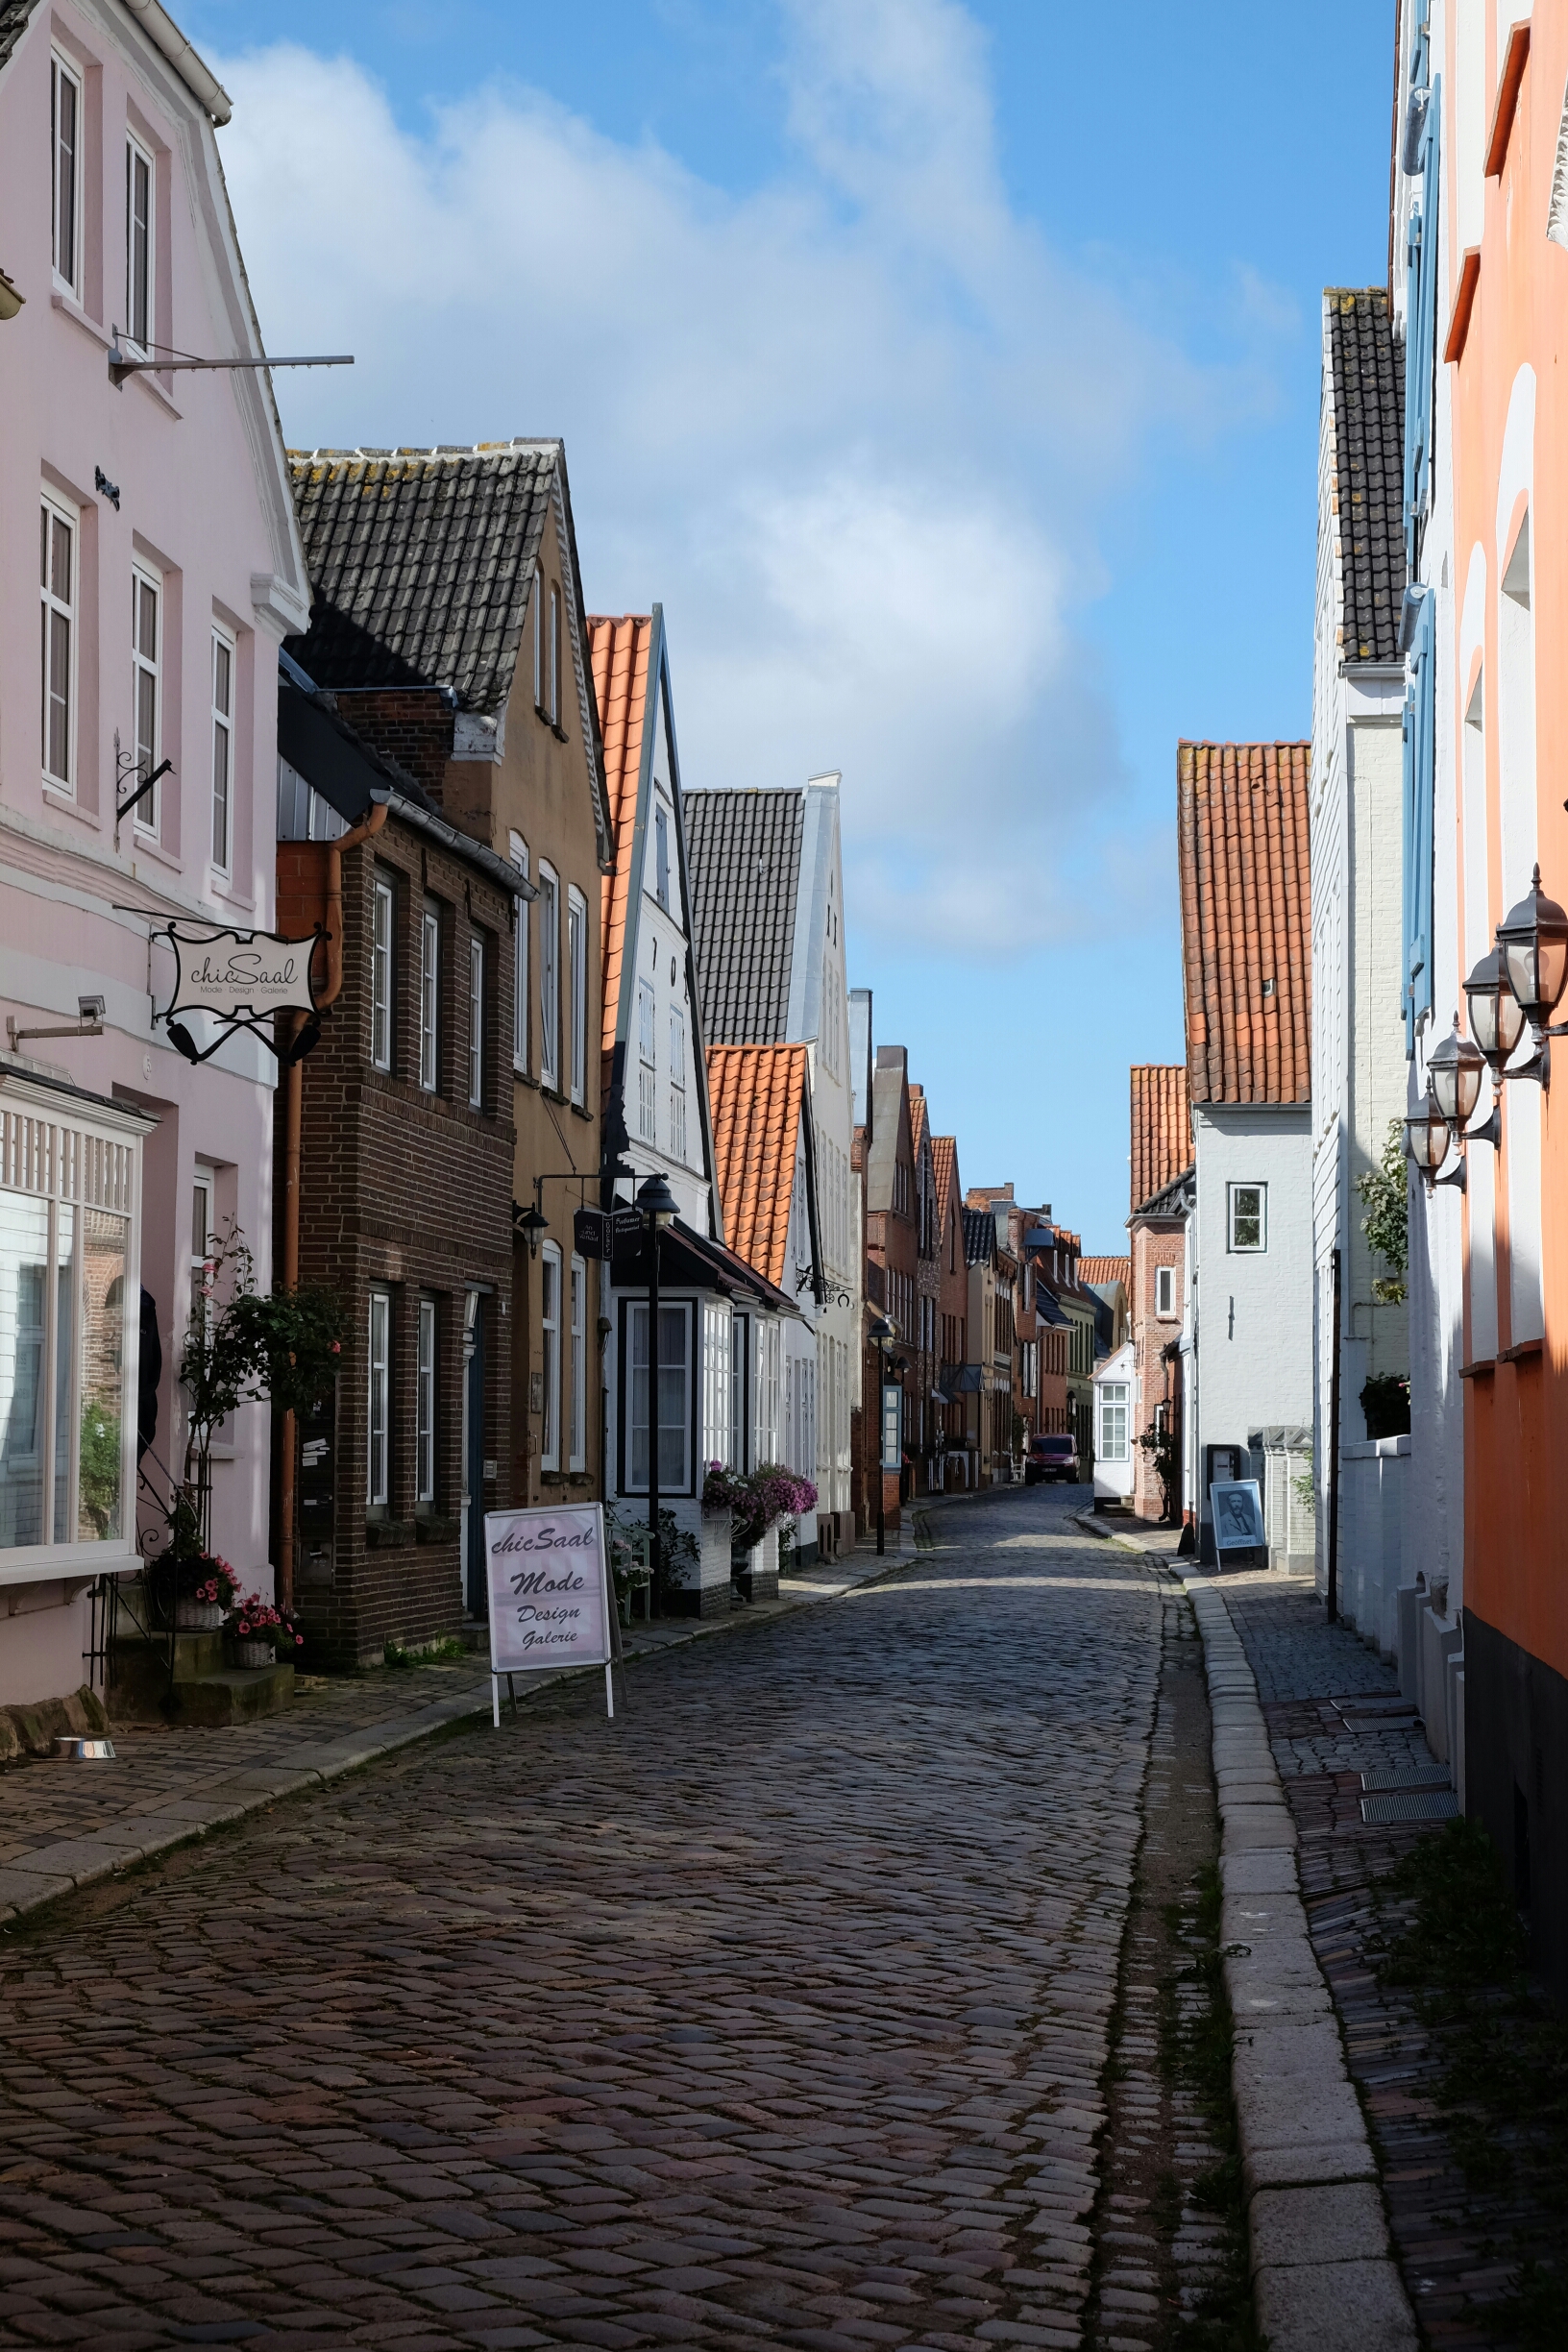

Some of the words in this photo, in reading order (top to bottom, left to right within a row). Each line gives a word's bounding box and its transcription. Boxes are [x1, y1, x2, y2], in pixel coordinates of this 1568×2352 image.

[190, 953, 299, 985] chicSaal
[229, 986, 255, 994] Design
[260, 986, 288, 994] Galerie
[491, 1527, 594, 1555] chicSaal
[509, 1571, 584, 1595] Mode
[516, 1605, 580, 1625] Design
[522, 1629, 578, 1651] Galerie
